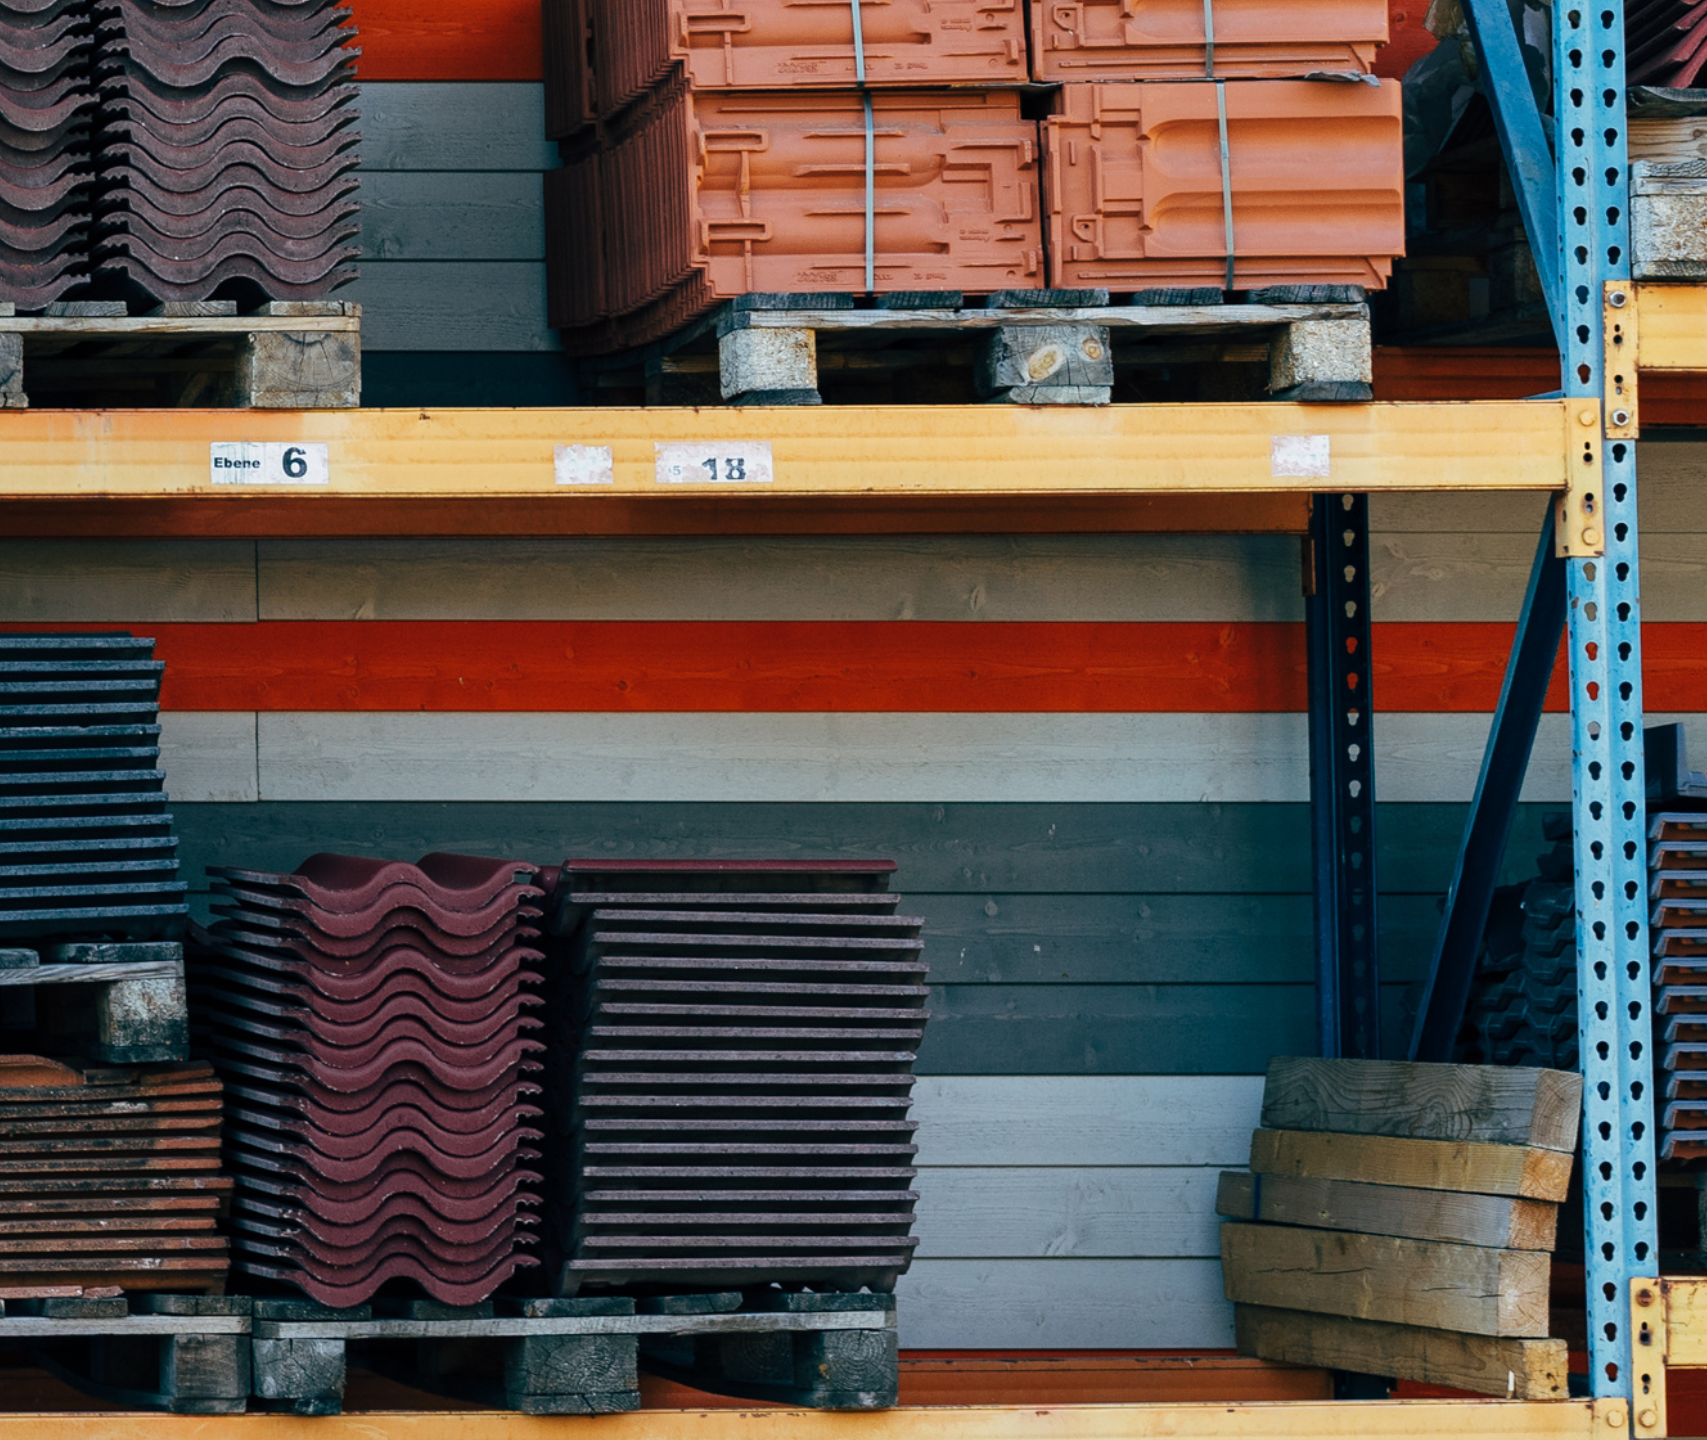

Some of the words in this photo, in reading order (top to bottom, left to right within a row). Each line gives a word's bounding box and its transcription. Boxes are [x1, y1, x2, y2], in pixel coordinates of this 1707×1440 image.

[213, 457, 261, 469] Ebene
[282, 447, 308, 479] 6
[701, 457, 746, 481] 18
